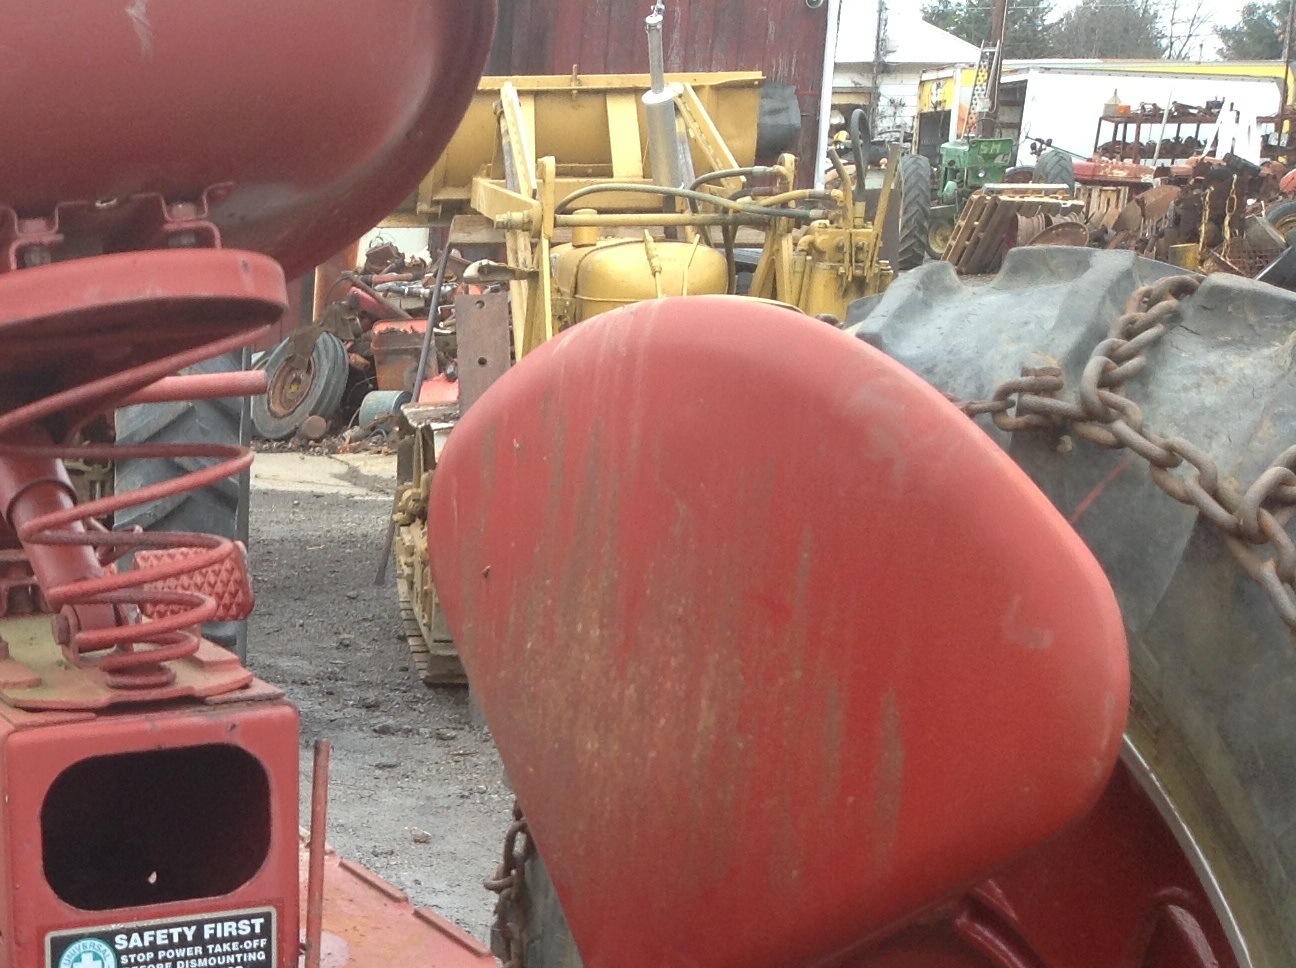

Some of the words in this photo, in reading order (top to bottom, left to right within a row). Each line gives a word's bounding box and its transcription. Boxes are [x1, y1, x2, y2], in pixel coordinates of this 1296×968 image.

[114, 925, 197, 950] SAFETY
[204, 918, 265, 939] FIRST
[63, 942, 110, 966] UNIVERSAL
[120, 952, 154, 964] STOP
[158, 946, 203, 959] POWER
[207, 938, 267, 954] TAKE-OFF
